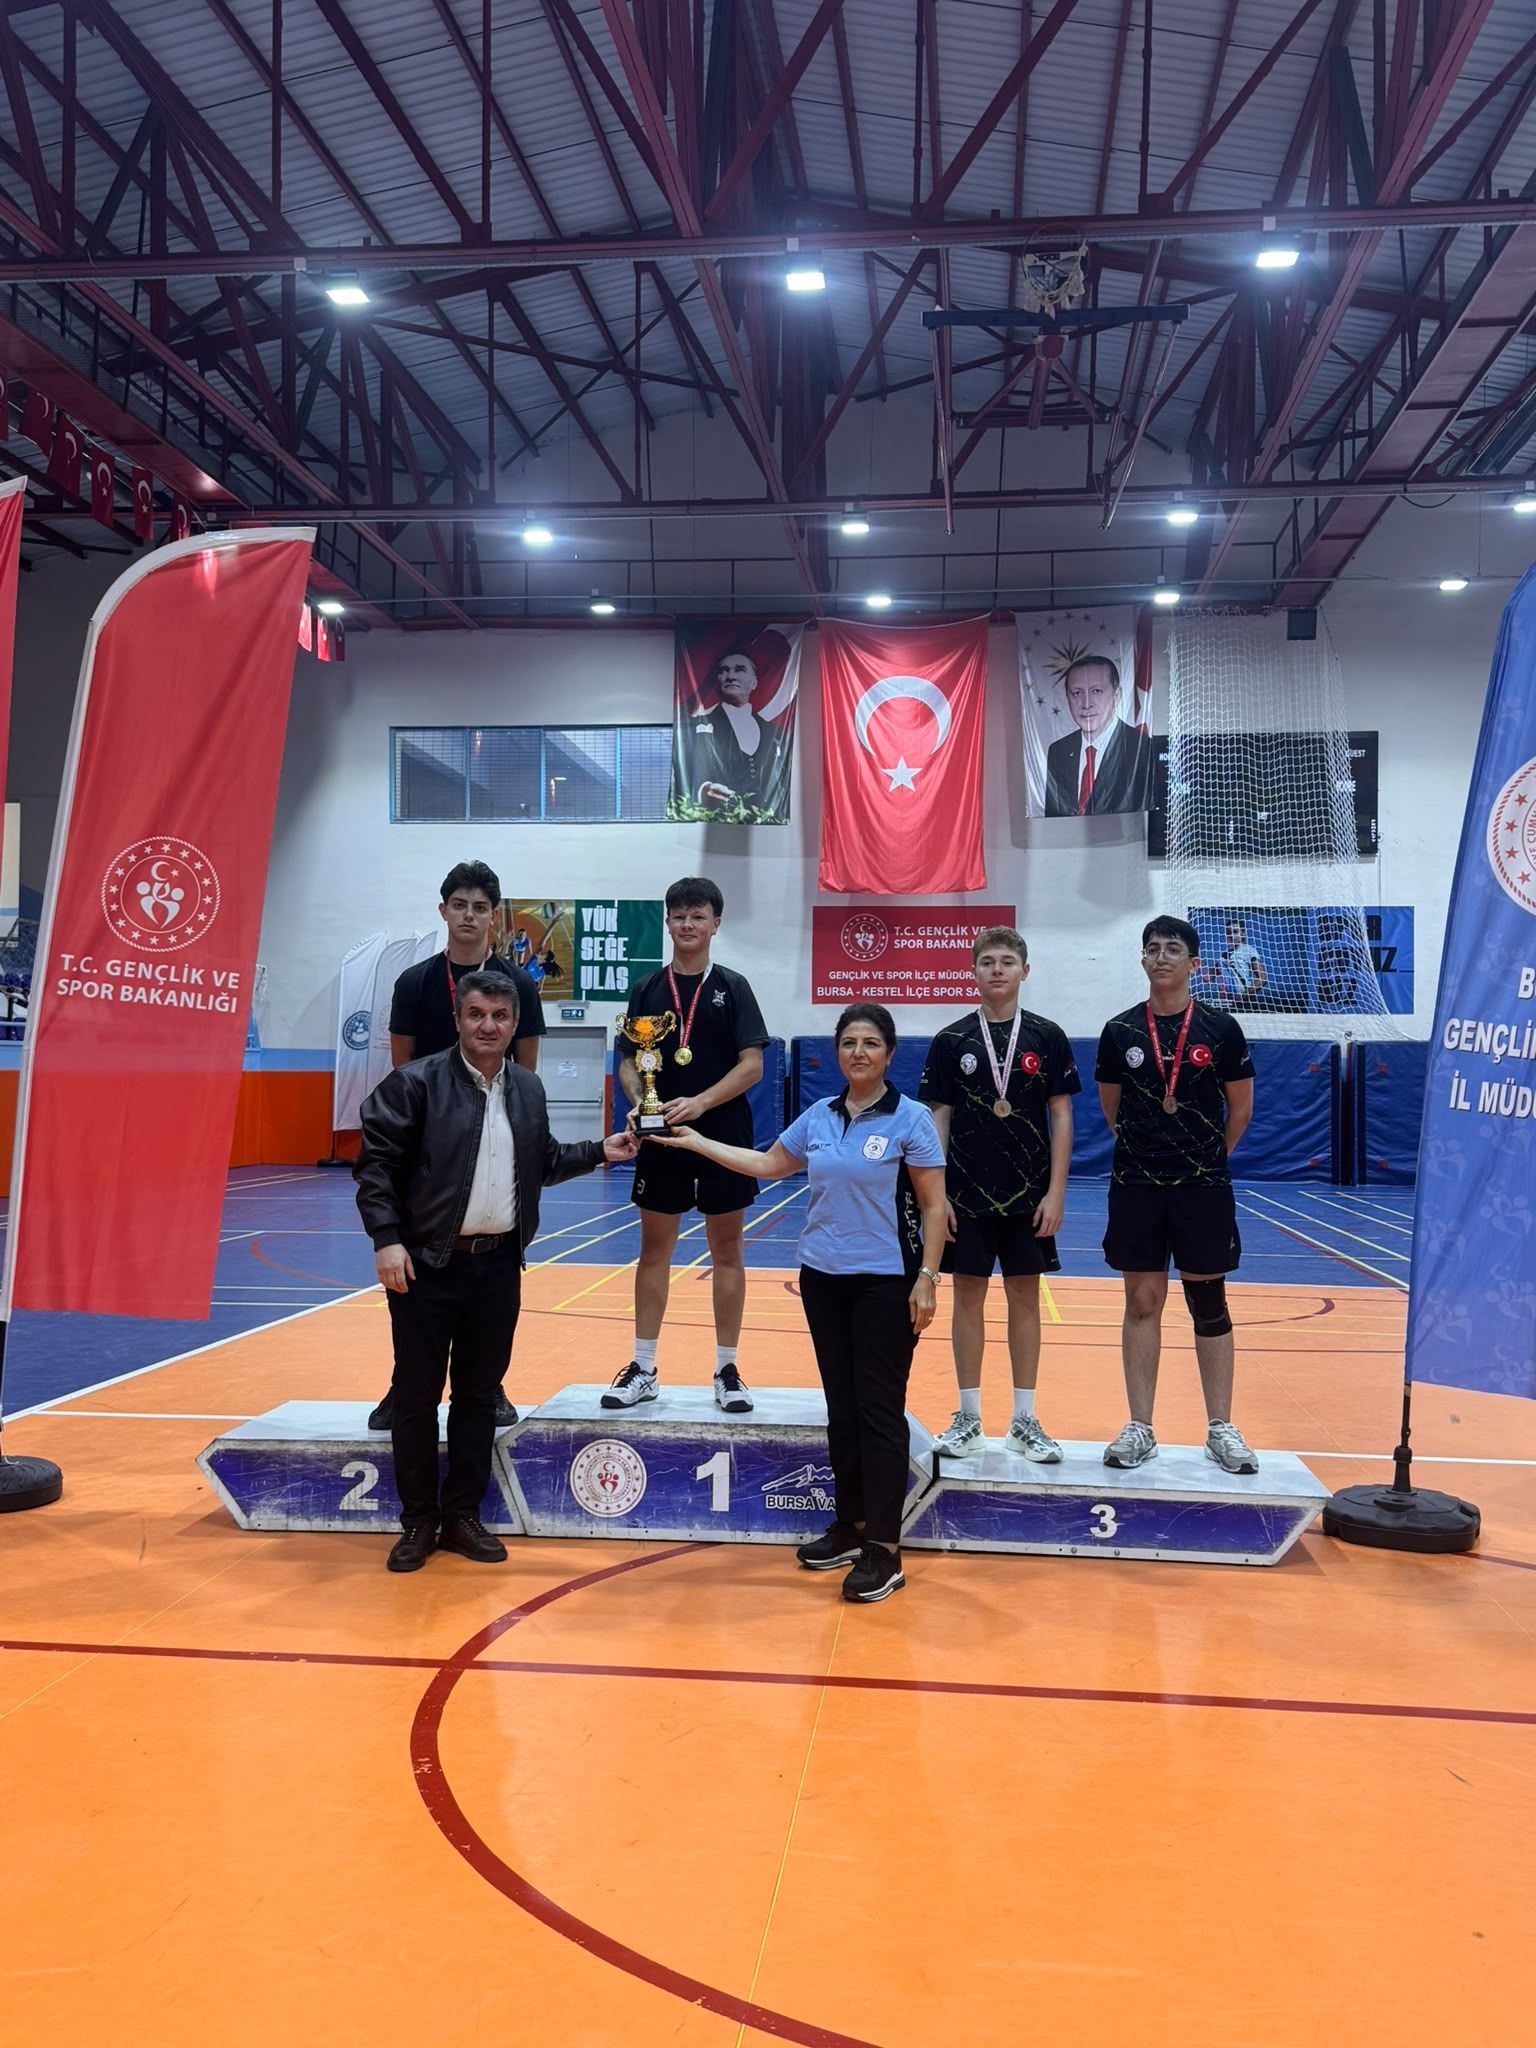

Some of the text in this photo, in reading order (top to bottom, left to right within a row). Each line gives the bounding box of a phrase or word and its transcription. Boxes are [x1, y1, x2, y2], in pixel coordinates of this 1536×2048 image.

[581, 905, 618, 932] YÜK
[894, 926, 914, 936] T.C.
[918, 924, 968, 938] GENÇLİK
[580, 934, 629, 961] SEĞE
[894, 939, 975, 949] SPOR BAKANLI
[60, 953, 240, 989] T.C. GENÇLİK VE
[580, 965, 629, 993] ULAŞ
[829, 969, 975, 981] GENÇLİK VE SPOR İLÇE MÜDÜR
[1517, 966, 1536, 999] B
[56, 978, 238, 1013] SPOR BAKANLIĞI
[816, 986, 854, 996] BURSA
[862, 986, 904, 996] KESTEL
[906, 985, 930, 998] İLÇE
[933, 986, 963, 997] SPOR
[966, 986, 981, 997] SA
[1448, 1069, 1471, 1111] İL
[338, 1461, 380, 1511] 2
[696, 1451, 731, 1512] 1
[766, 1494, 836, 1511] BURSA VA
[1088, 1504, 1118, 1539] 3
